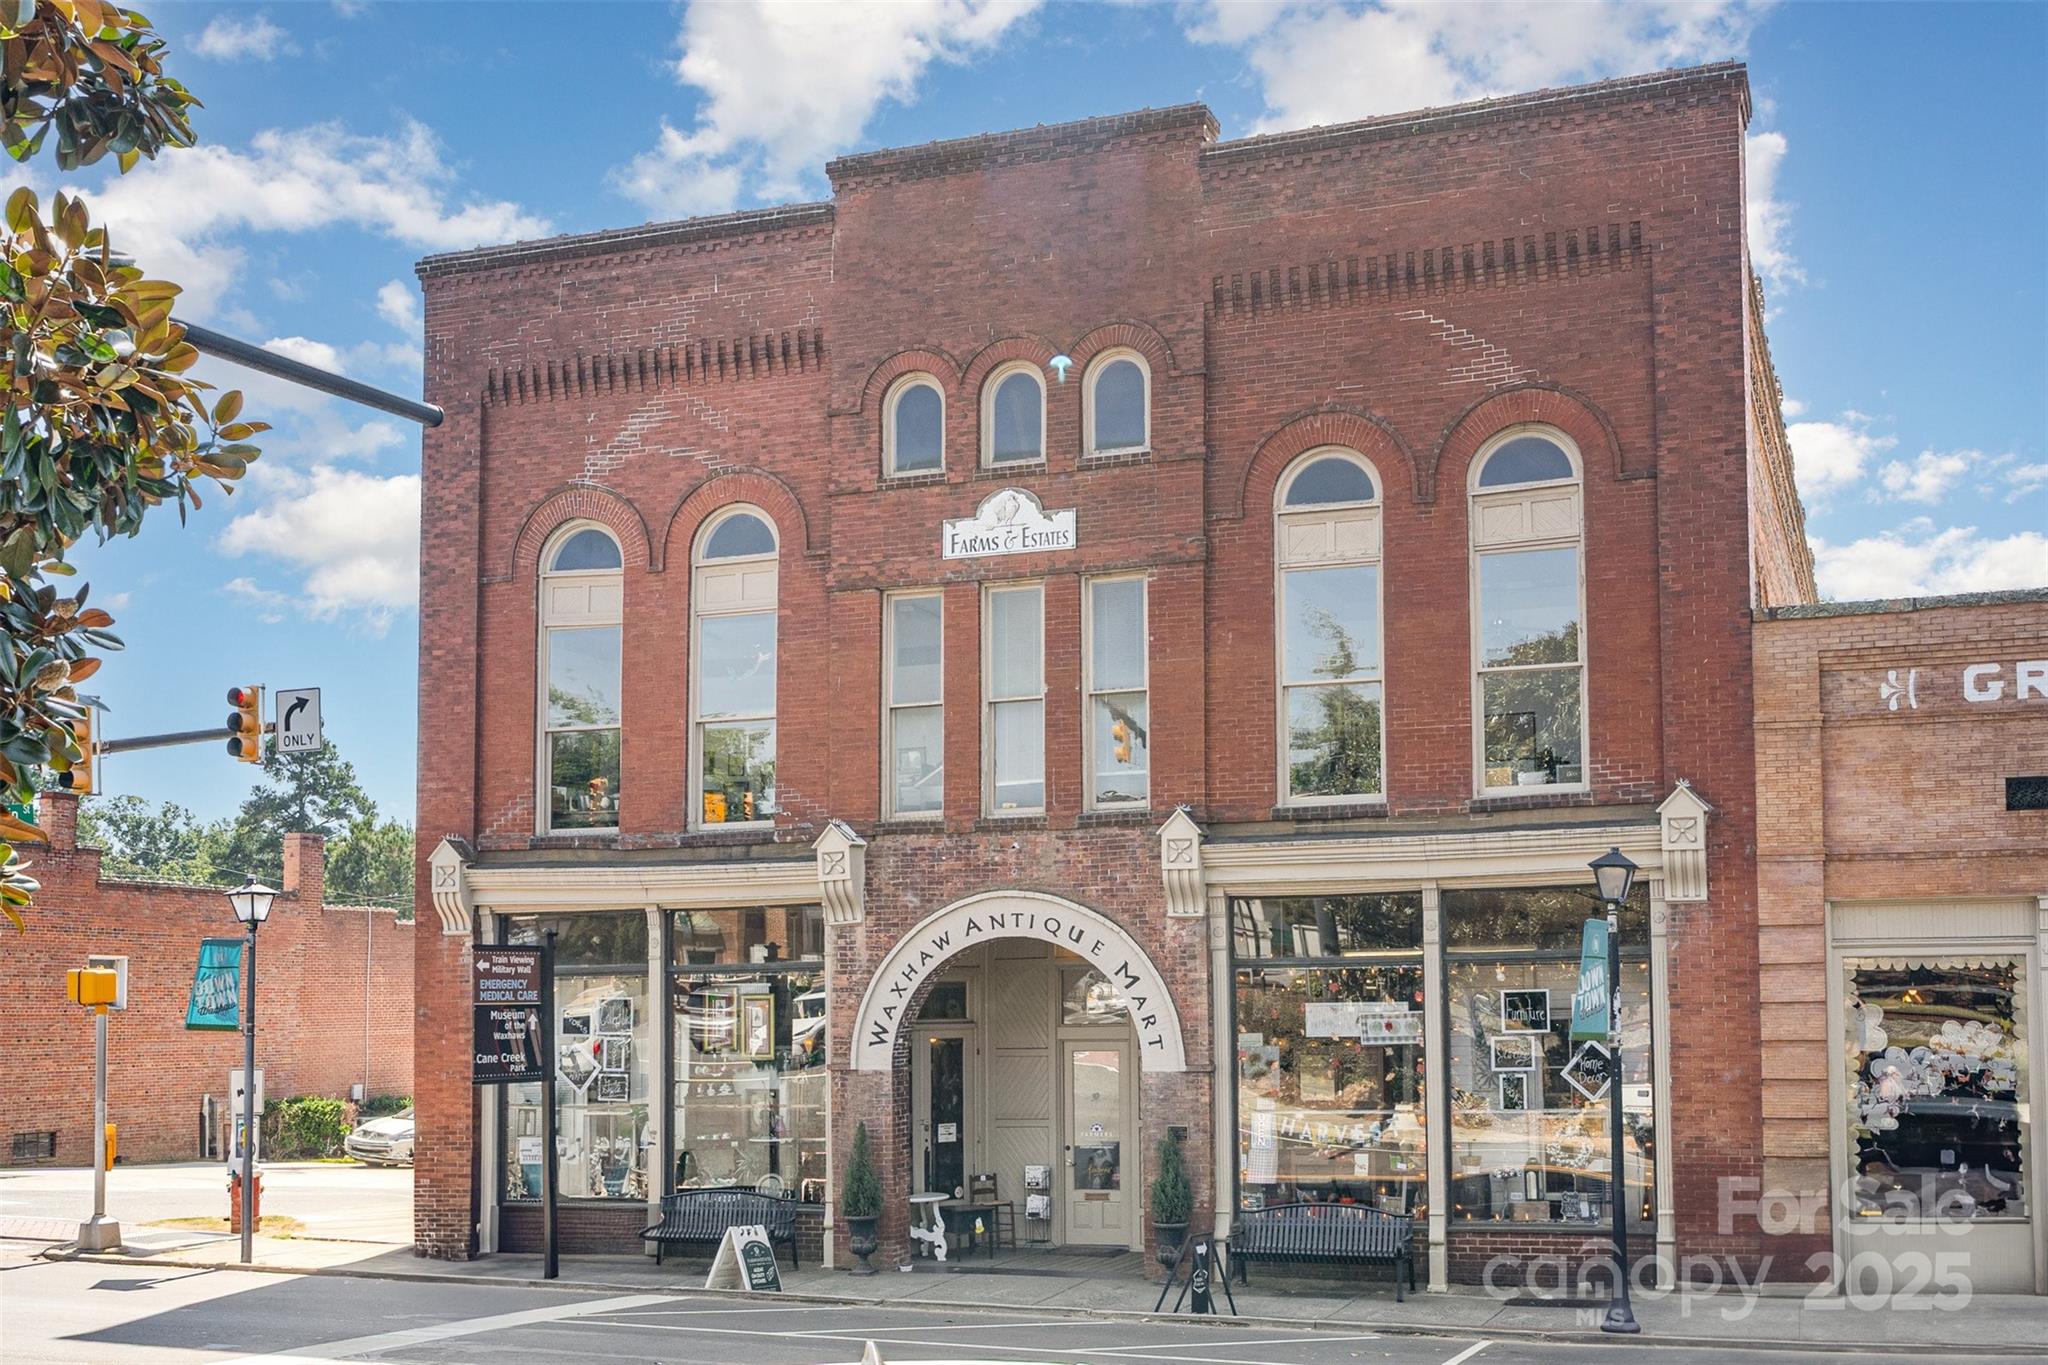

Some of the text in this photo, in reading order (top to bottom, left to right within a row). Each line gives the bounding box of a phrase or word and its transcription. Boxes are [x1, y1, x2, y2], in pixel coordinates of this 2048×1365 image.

[951, 526, 1069, 554] FARMS & ESTATES
[283, 733, 314, 747] ONLY
[492, 956, 535, 966] Train Viewing
[492, 965, 531, 975] Military Wall
[480, 979, 527, 989] EMERGENCY
[869, 913, 1163, 1050] WAXHAW ANTIQUE MART
[480, 991, 538, 1001] MEDICAL CARE
[1506, 994, 1545, 1021] Furniture
[490, 1010, 525, 1020] Museum
[504, 1021, 526, 1030] of the
[493, 1031, 526, 1040] Waxhaws
[476, 1053, 526, 1064] Cane Creek
[510, 1064, 526, 1072] Park
[1579, 1057, 1604, 1071] Home
